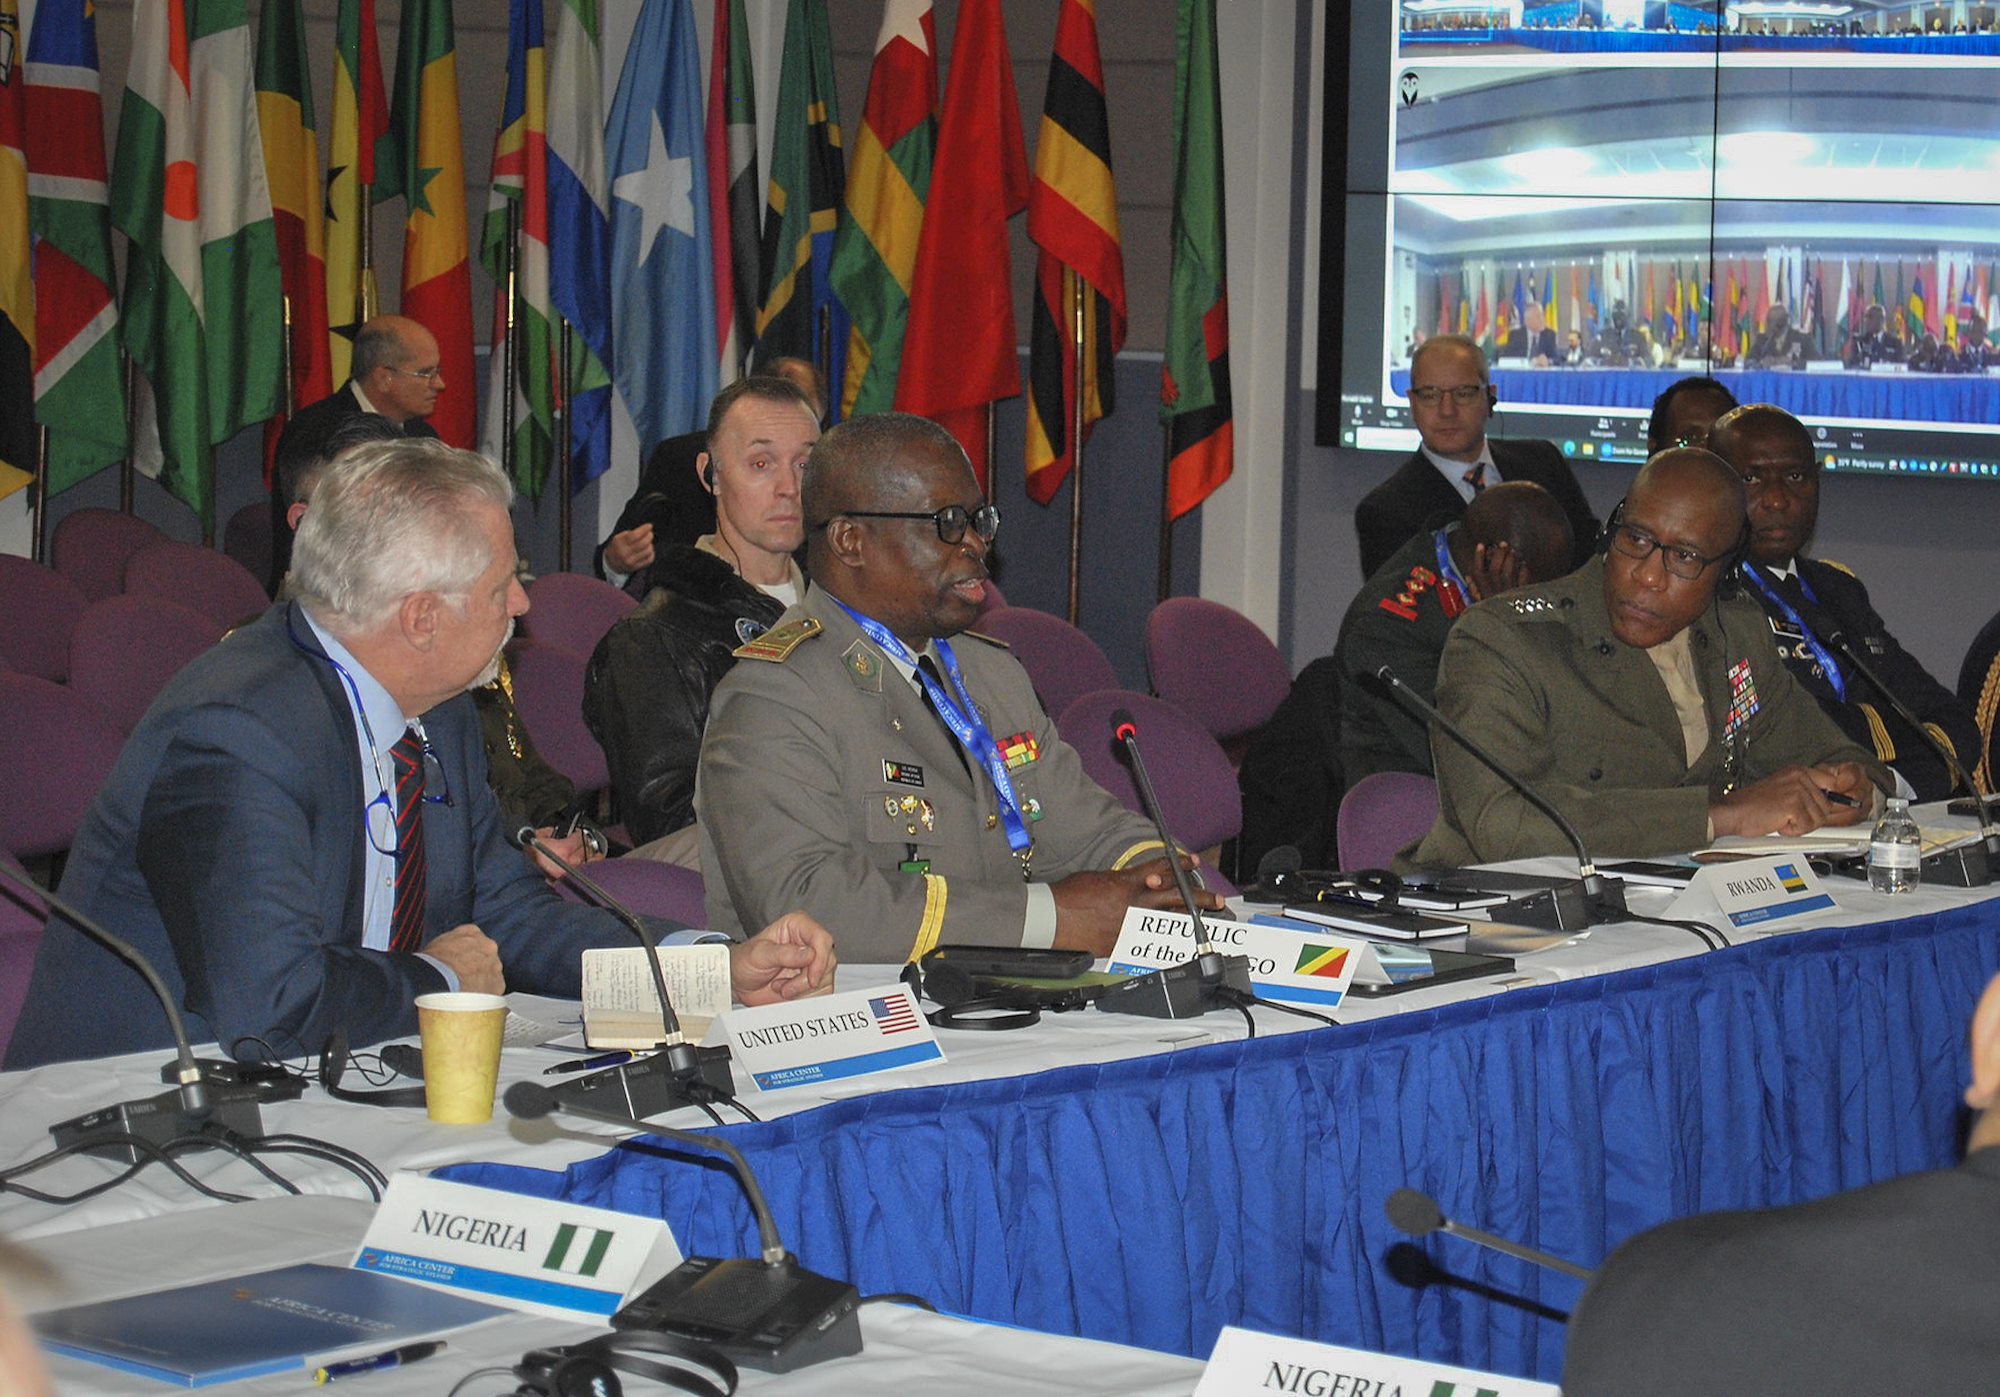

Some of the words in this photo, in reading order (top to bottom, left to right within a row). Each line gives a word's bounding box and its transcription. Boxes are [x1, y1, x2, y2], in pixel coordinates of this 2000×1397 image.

[1726, 876, 1776, 897] RWANDA
[1131, 942, 1153, 957] of
[1156, 945, 1185, 963] the
[738, 1023, 805, 1049] UNITED
[806, 1011, 869, 1037] STATES
[770, 1071, 795, 1080] AFRICA
[412, 1209, 527, 1252] NIGERIA
[382, 1254, 417, 1267] AFRICA
[418, 1261, 456, 1275] CENTER
